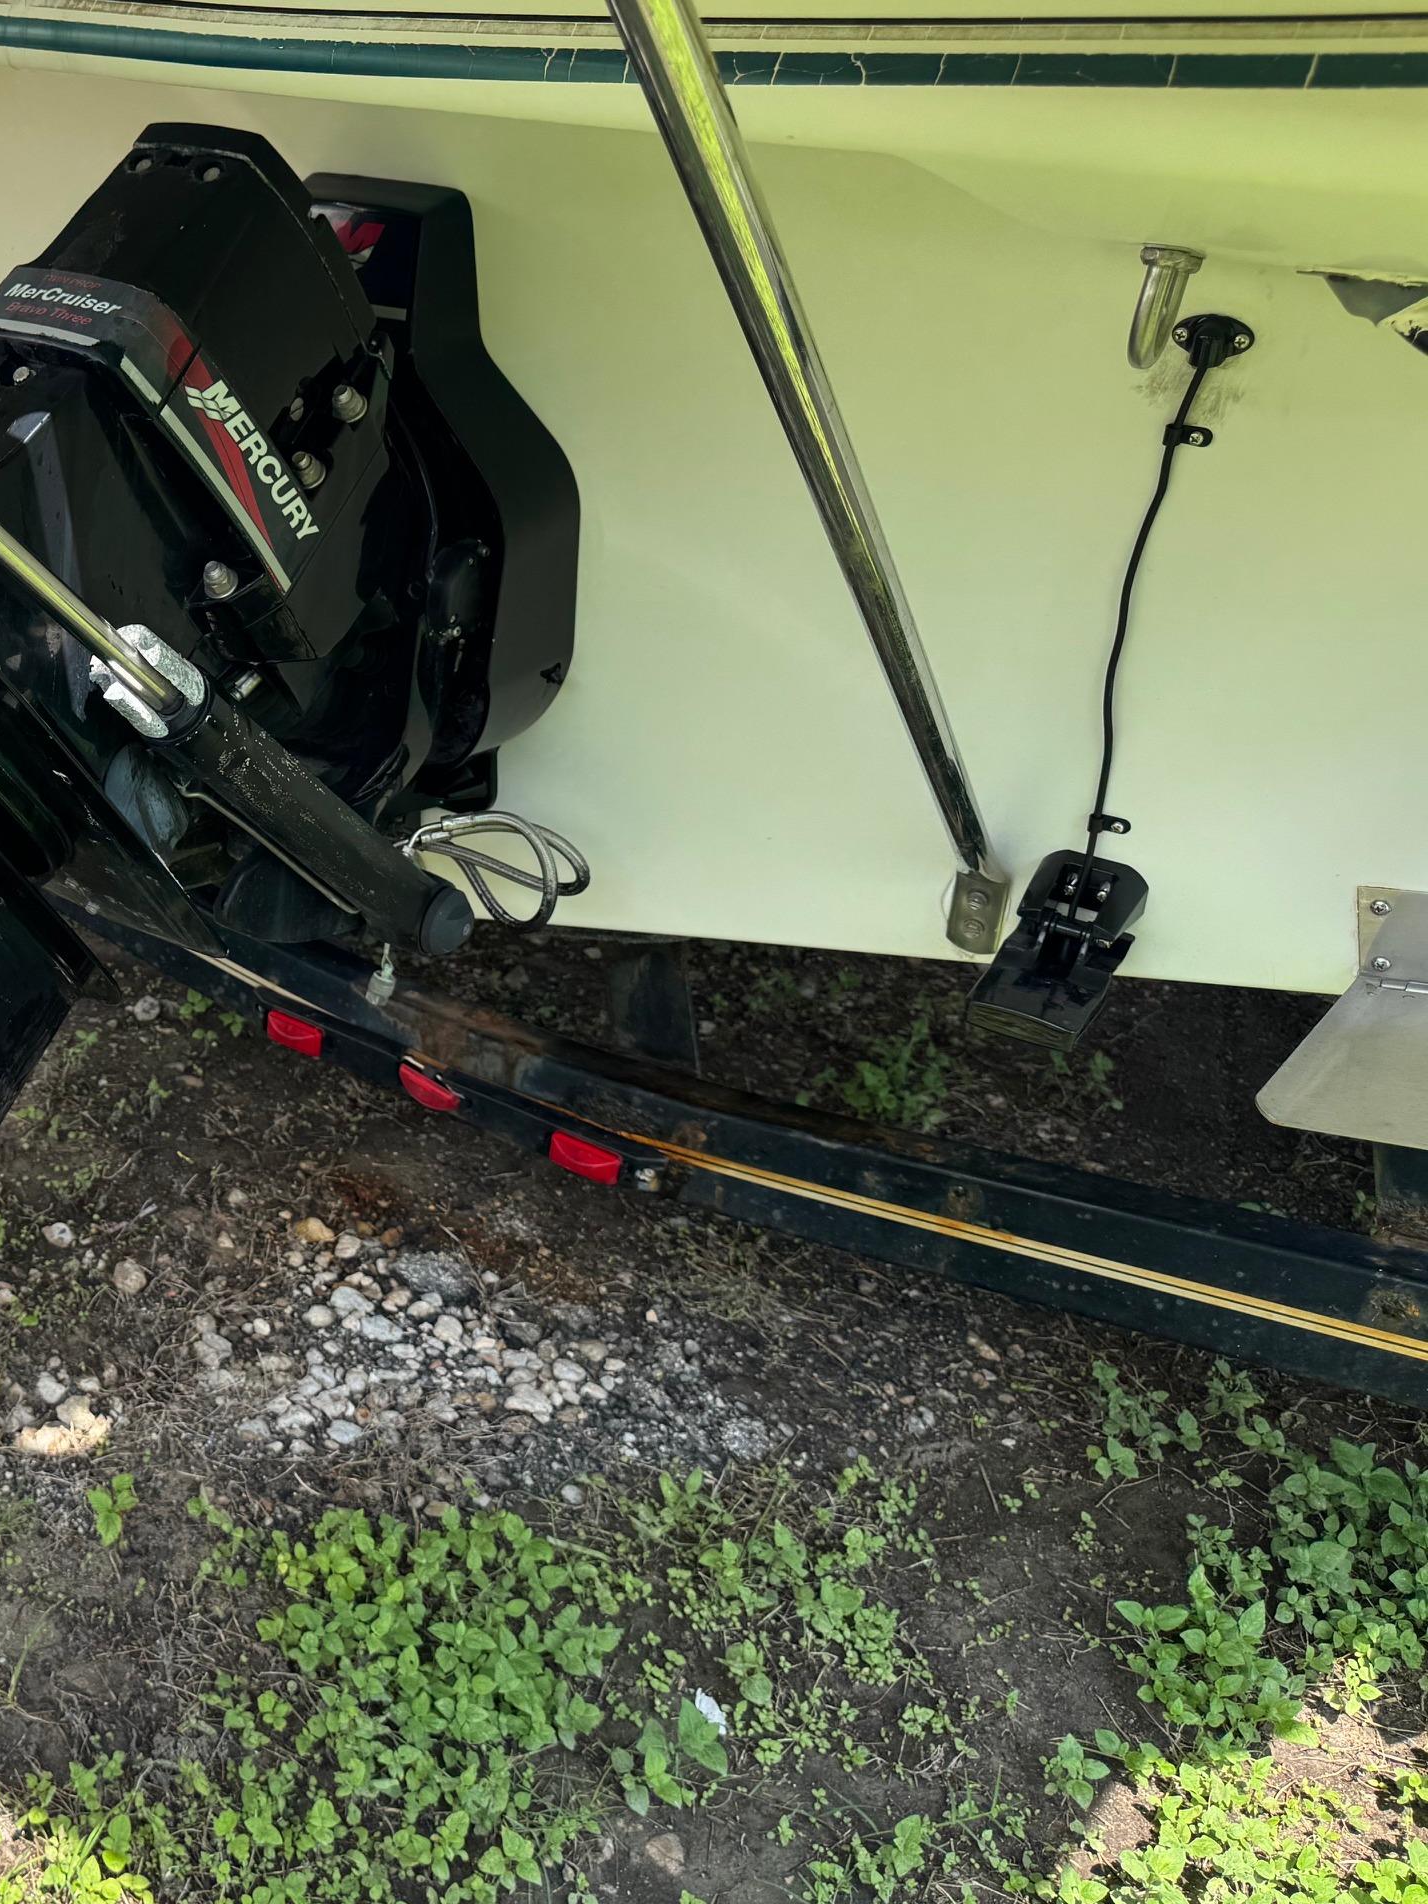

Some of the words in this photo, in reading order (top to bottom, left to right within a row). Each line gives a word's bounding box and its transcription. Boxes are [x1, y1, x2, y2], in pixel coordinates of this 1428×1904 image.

[3, 282, 123, 315] MerCruiser
[5, 301, 48, 316] Bravo
[50, 306, 93, 326] Three
[185, 379, 320, 540] MERCURY
